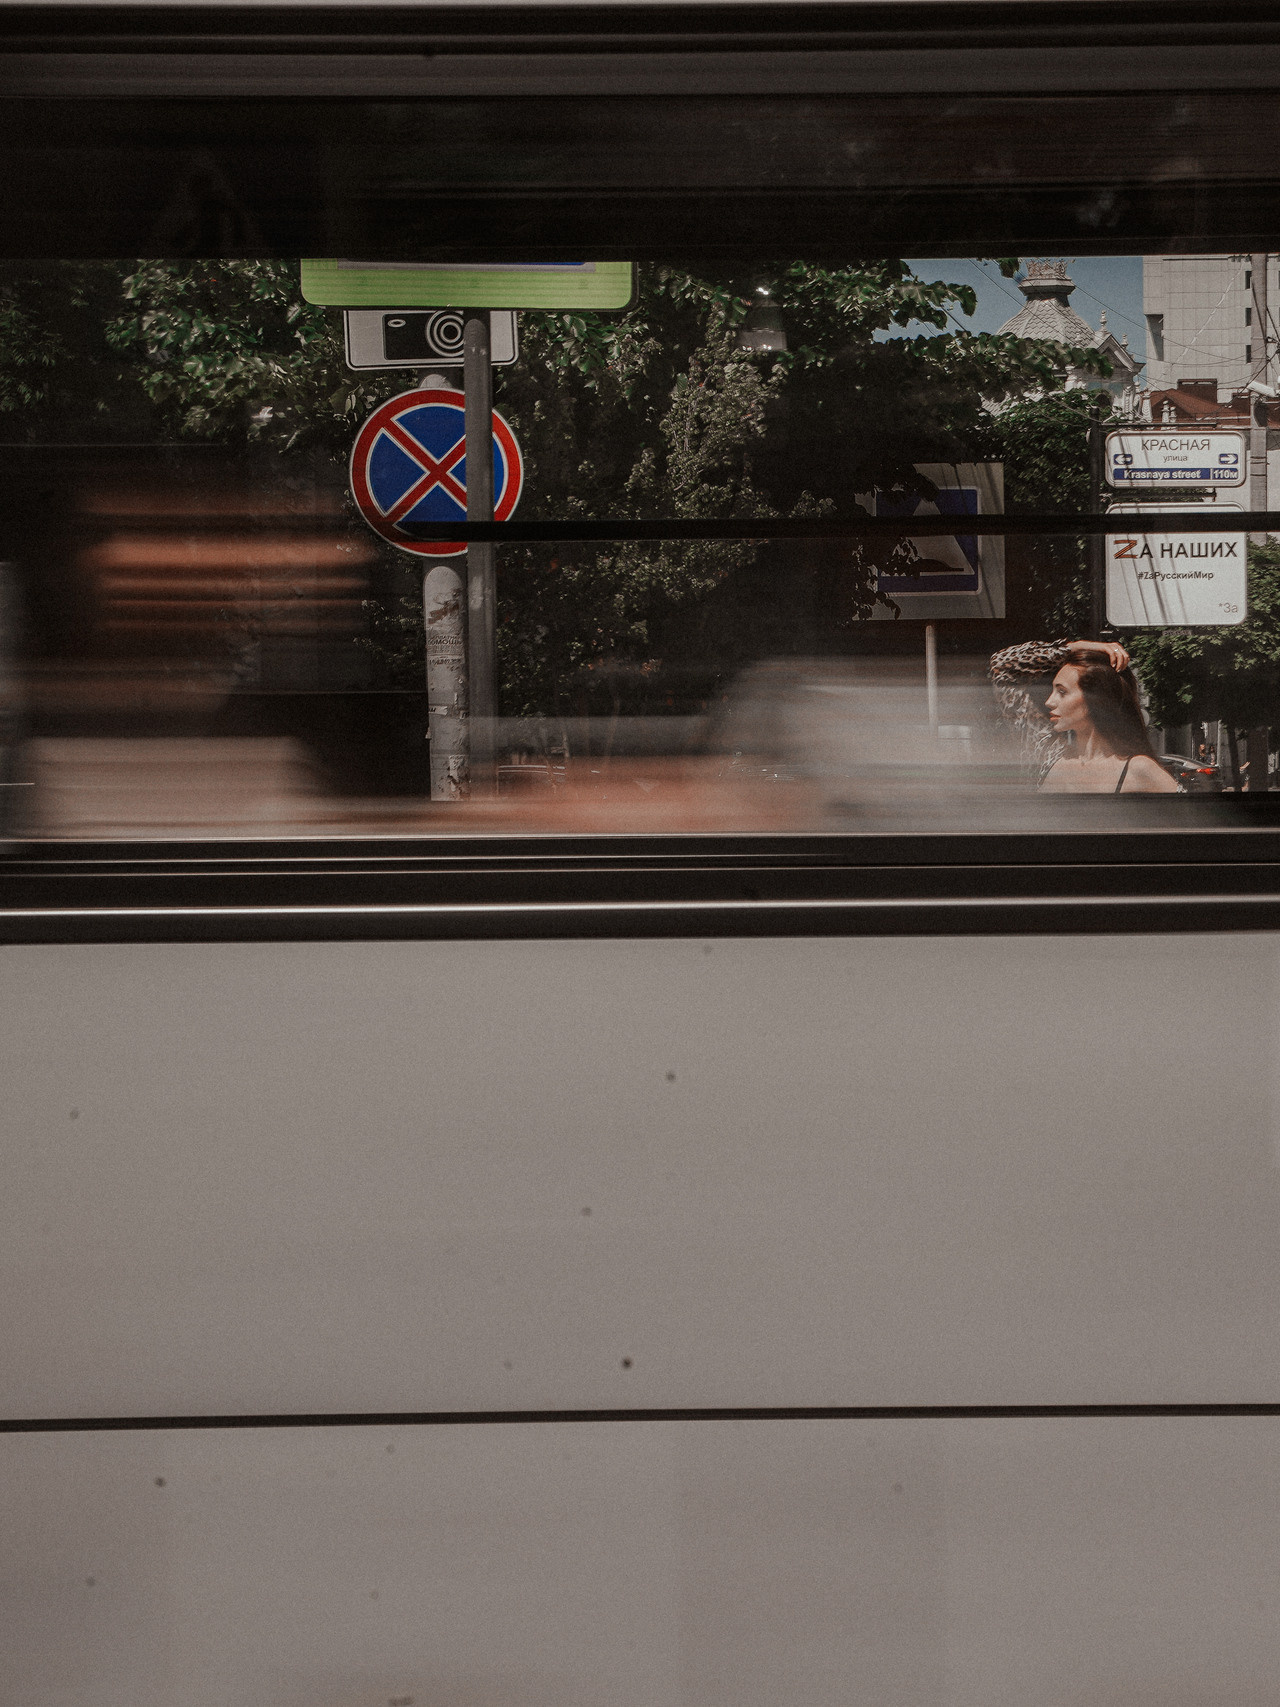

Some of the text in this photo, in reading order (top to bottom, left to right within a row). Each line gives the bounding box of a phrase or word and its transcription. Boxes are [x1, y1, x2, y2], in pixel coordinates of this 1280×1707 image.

[1141, 438, 1211, 451] КРАСНАЯ
[1163, 455, 1188, 463] улица
[1123, 469, 1201, 480] Krasnaya street
[1213, 469, 1238, 479] 110м
[1160, 541, 1238, 559] НАШИХ
